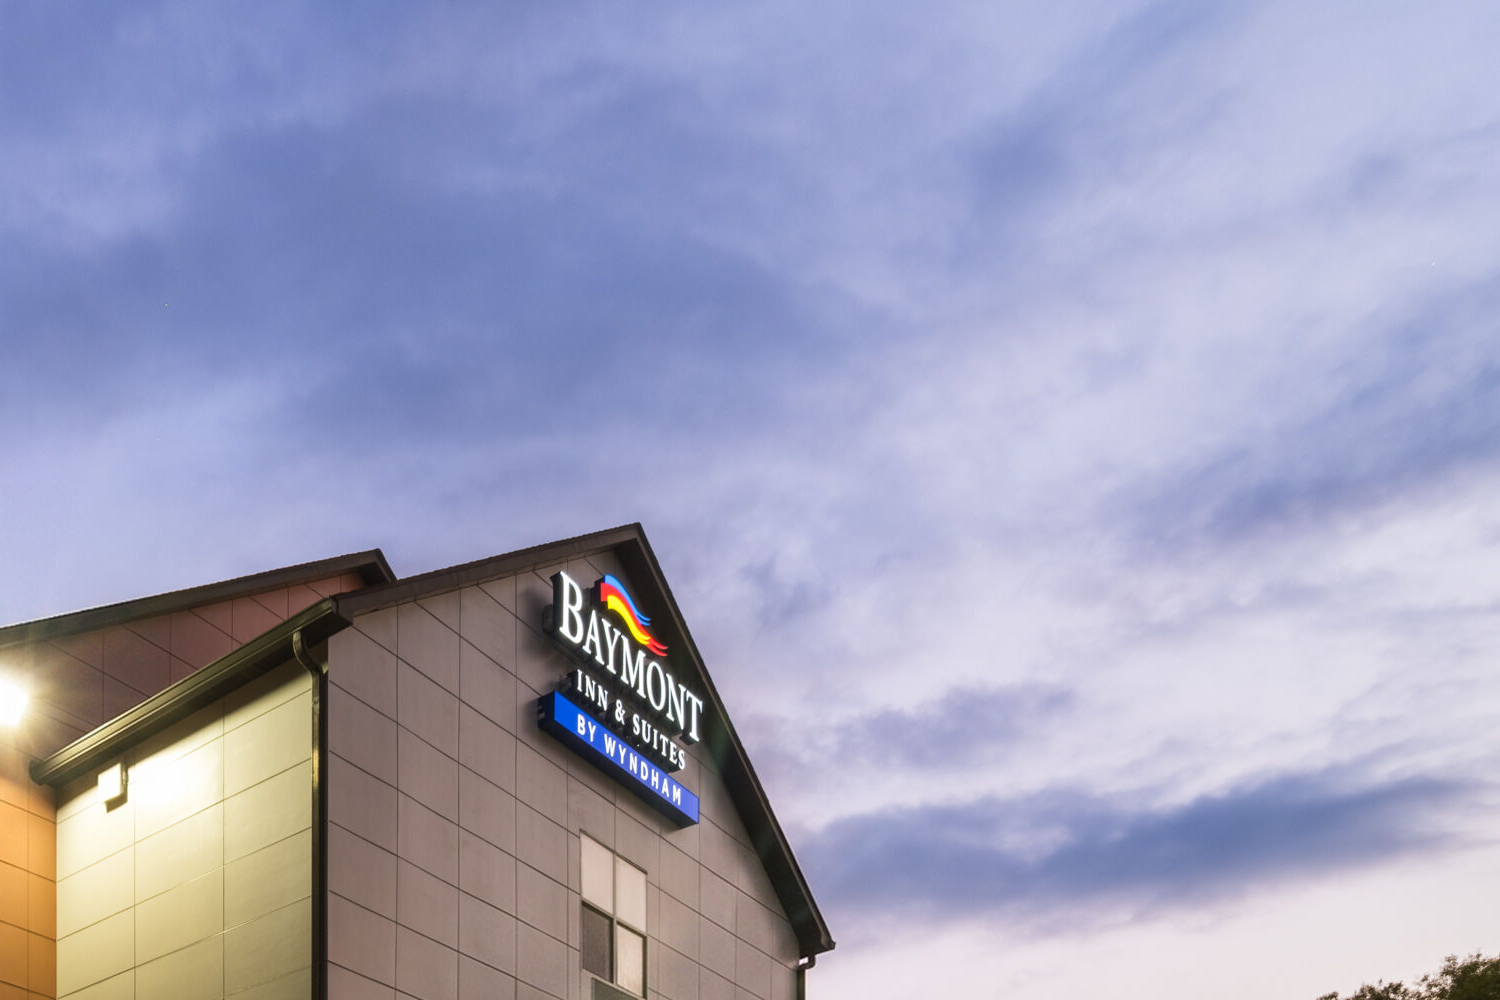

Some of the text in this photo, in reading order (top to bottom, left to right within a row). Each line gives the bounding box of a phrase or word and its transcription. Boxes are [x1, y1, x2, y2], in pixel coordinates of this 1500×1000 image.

[559, 571, 703, 742] BAYMONT
[577, 669, 686, 770] INN & SUITES
[577, 714, 682, 806] BY WYNDHAM
